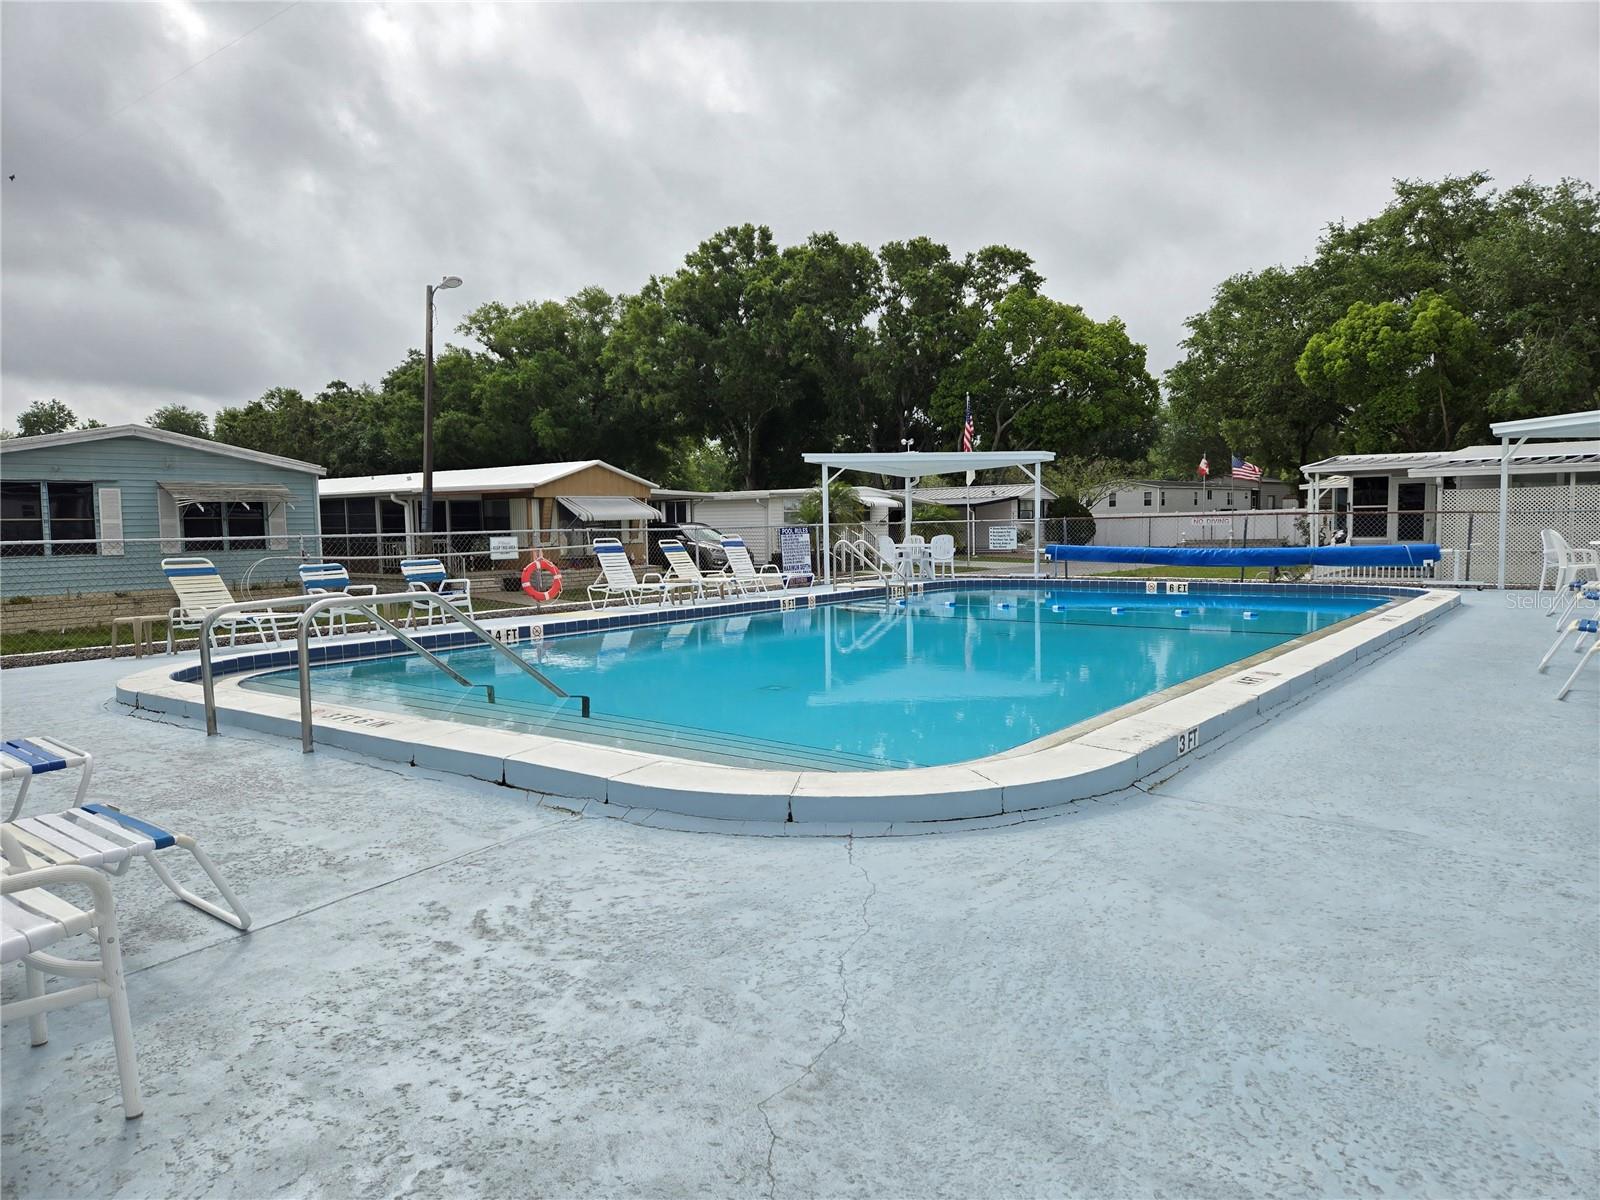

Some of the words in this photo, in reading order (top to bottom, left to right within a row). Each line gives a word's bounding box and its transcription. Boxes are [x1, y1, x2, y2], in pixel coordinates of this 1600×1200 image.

[1169, 584, 1175, 592] 6
[495, 630, 502, 641] 4
[506, 629, 517, 640] FT
[1179, 734, 1186, 753] 3
[1187, 728, 1198, 750] FT
